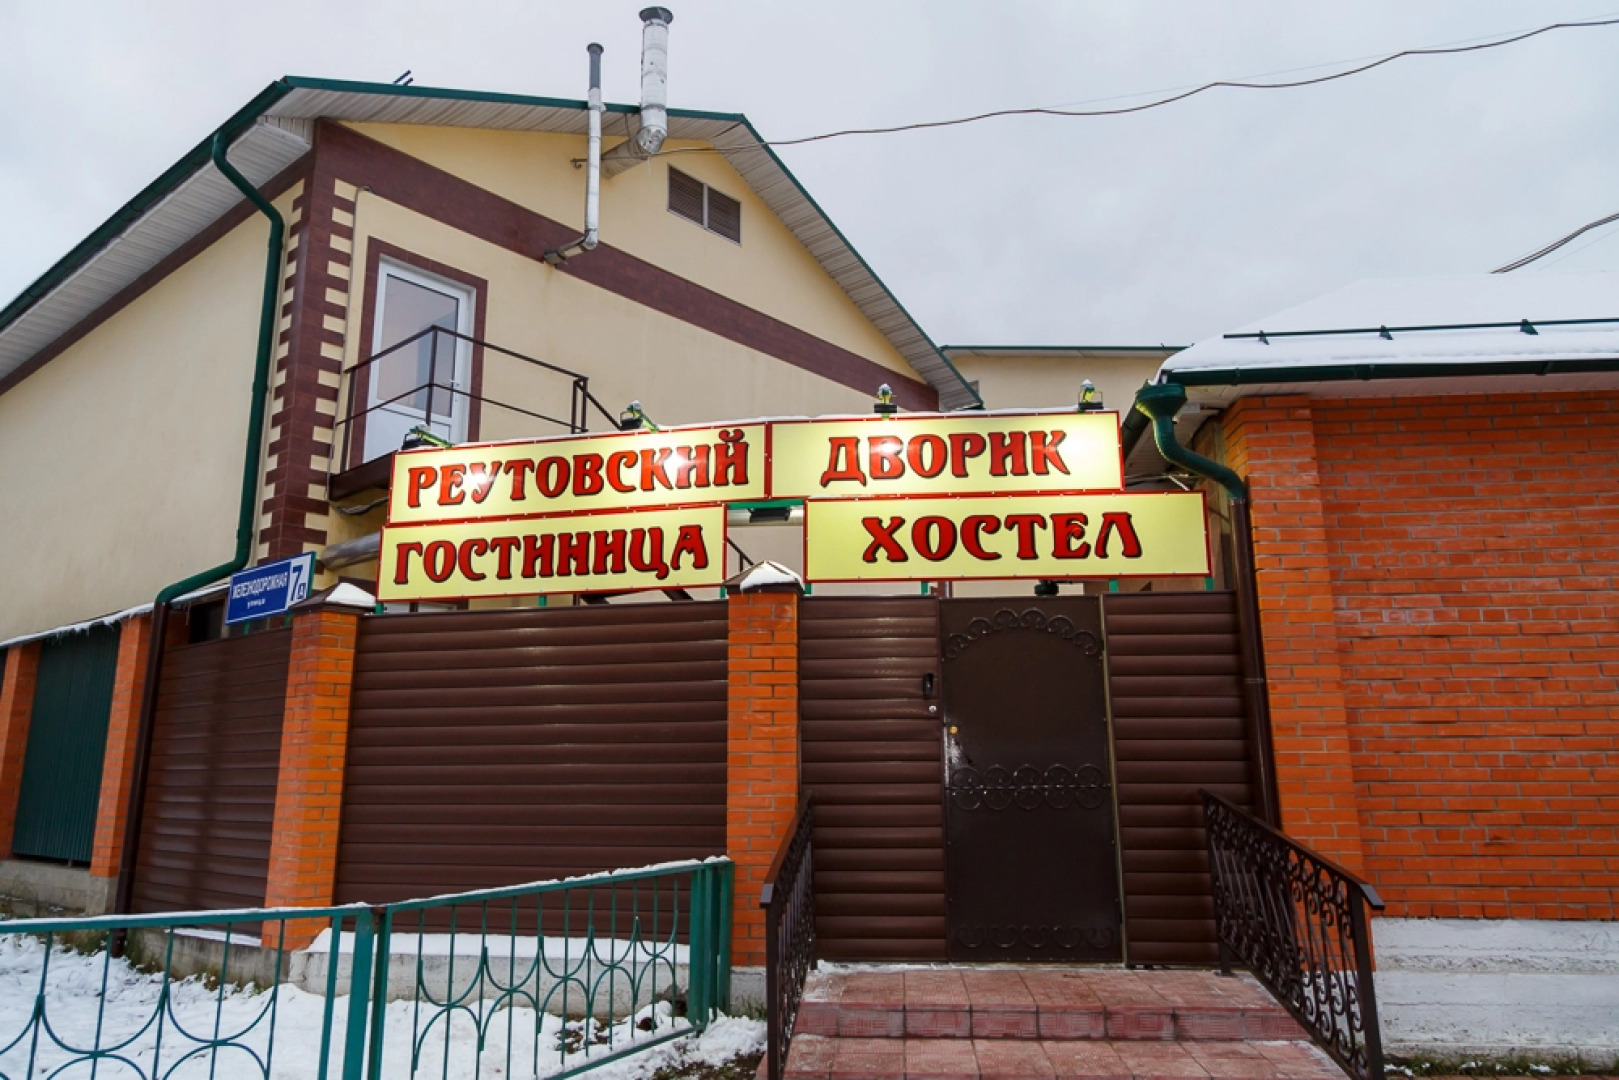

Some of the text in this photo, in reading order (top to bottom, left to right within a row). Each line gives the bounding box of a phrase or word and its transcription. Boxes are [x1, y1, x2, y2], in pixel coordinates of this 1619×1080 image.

[407, 428, 1071, 508] РЕУТОВСКИЙ ДВОРИК
[393, 524, 709, 585] ГОСТИНИЦА
[861, 511, 1143, 563] ХОСТЕЛ
